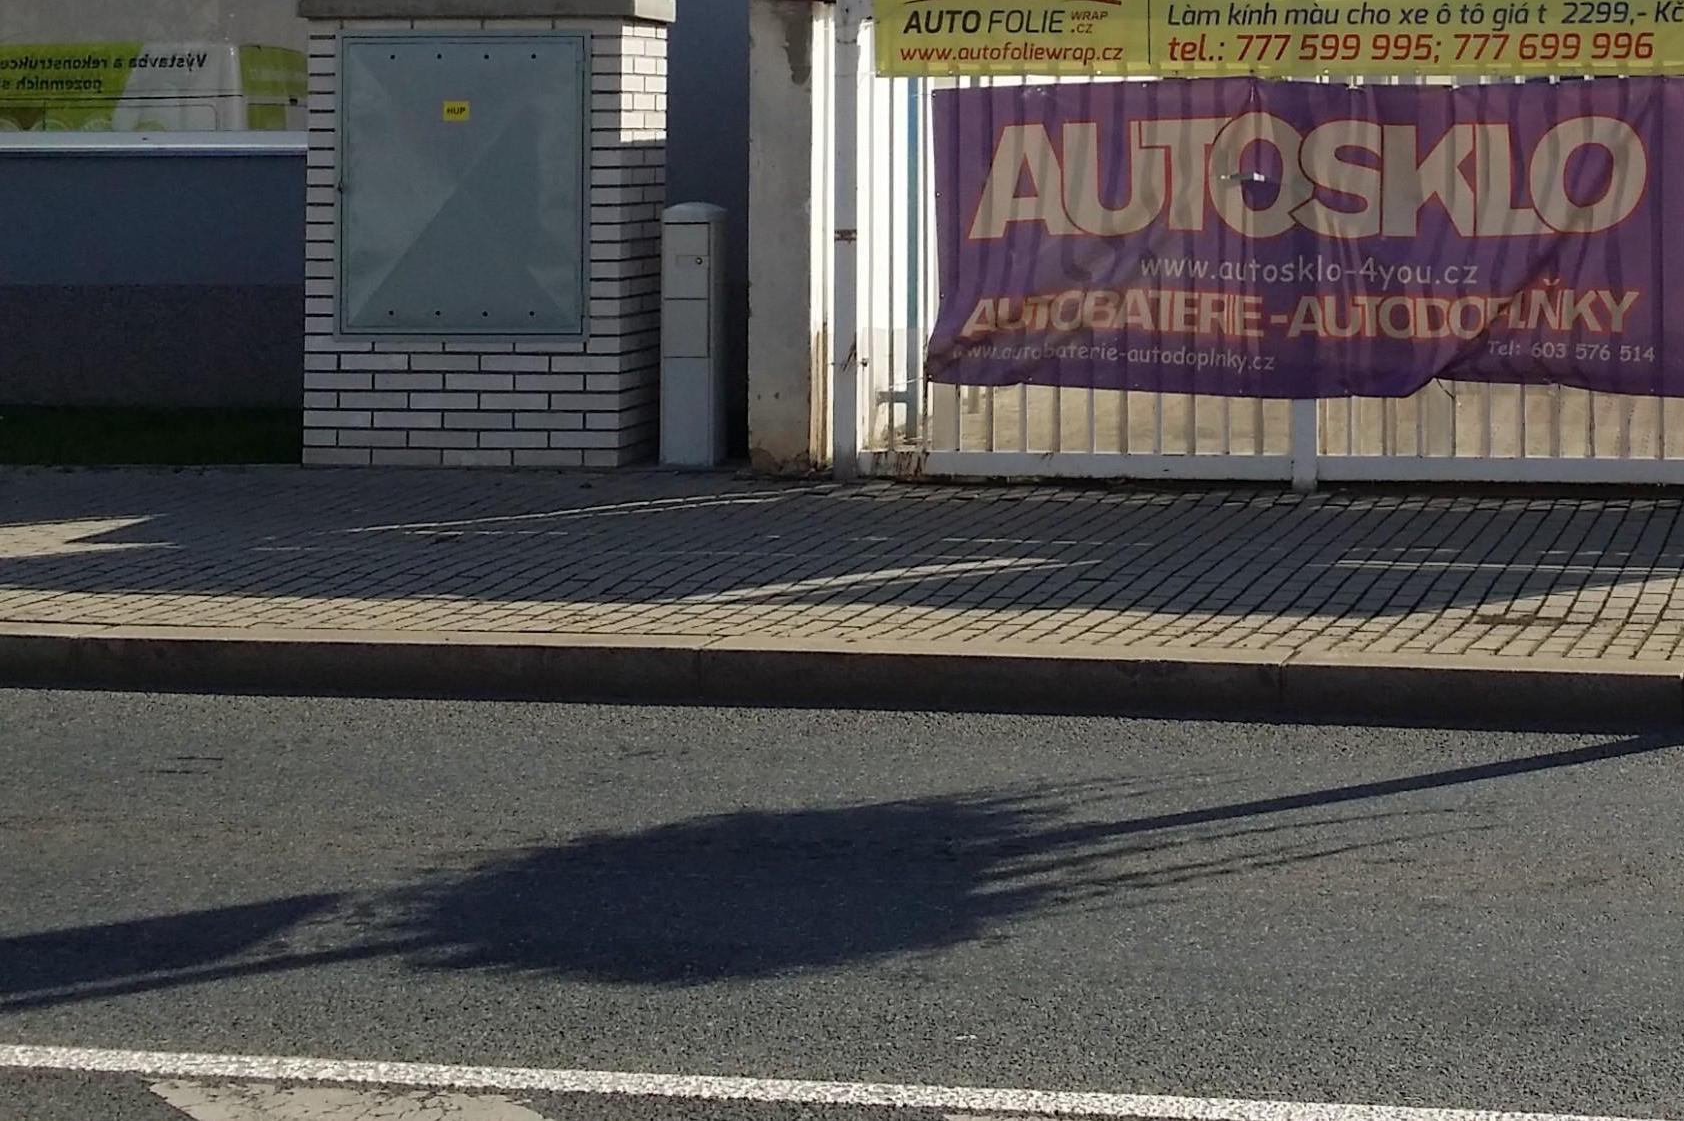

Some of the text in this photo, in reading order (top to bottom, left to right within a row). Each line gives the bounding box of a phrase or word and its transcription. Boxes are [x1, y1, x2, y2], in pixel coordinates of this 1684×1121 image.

[903, 10, 1108, 34] AUTO FOLIE WRAP
[1167, 4, 1220, 26] Làm
[1227, 2, 1278, 26] kính
[1284, 2, 1339, 25] màu
[1346, 1, 1391, 25] cho
[1398, 8, 1428, 24] xe
[1436, 3, 1451, 24] ô
[1460, 2, 1485, 24] tô
[1492, 2, 1530, 32] giá
[1561, 2, 1647, 26] 2299,-
[900, 43, 1123, 66] www.autofoliewrap.cz
[1168, 32, 1655, 63] tel.: 777 599 995; 777 699 996
[446, 107, 466, 115] HUP
[968, 111, 1648, 240] AUTOSKLO
[1139, 253, 1478, 290] www.autosklo-4you.cz
[1531, 341, 1566, 358] 603
[1575, 343, 1611, 360] 576
[1620, 345, 1655, 362] 514
